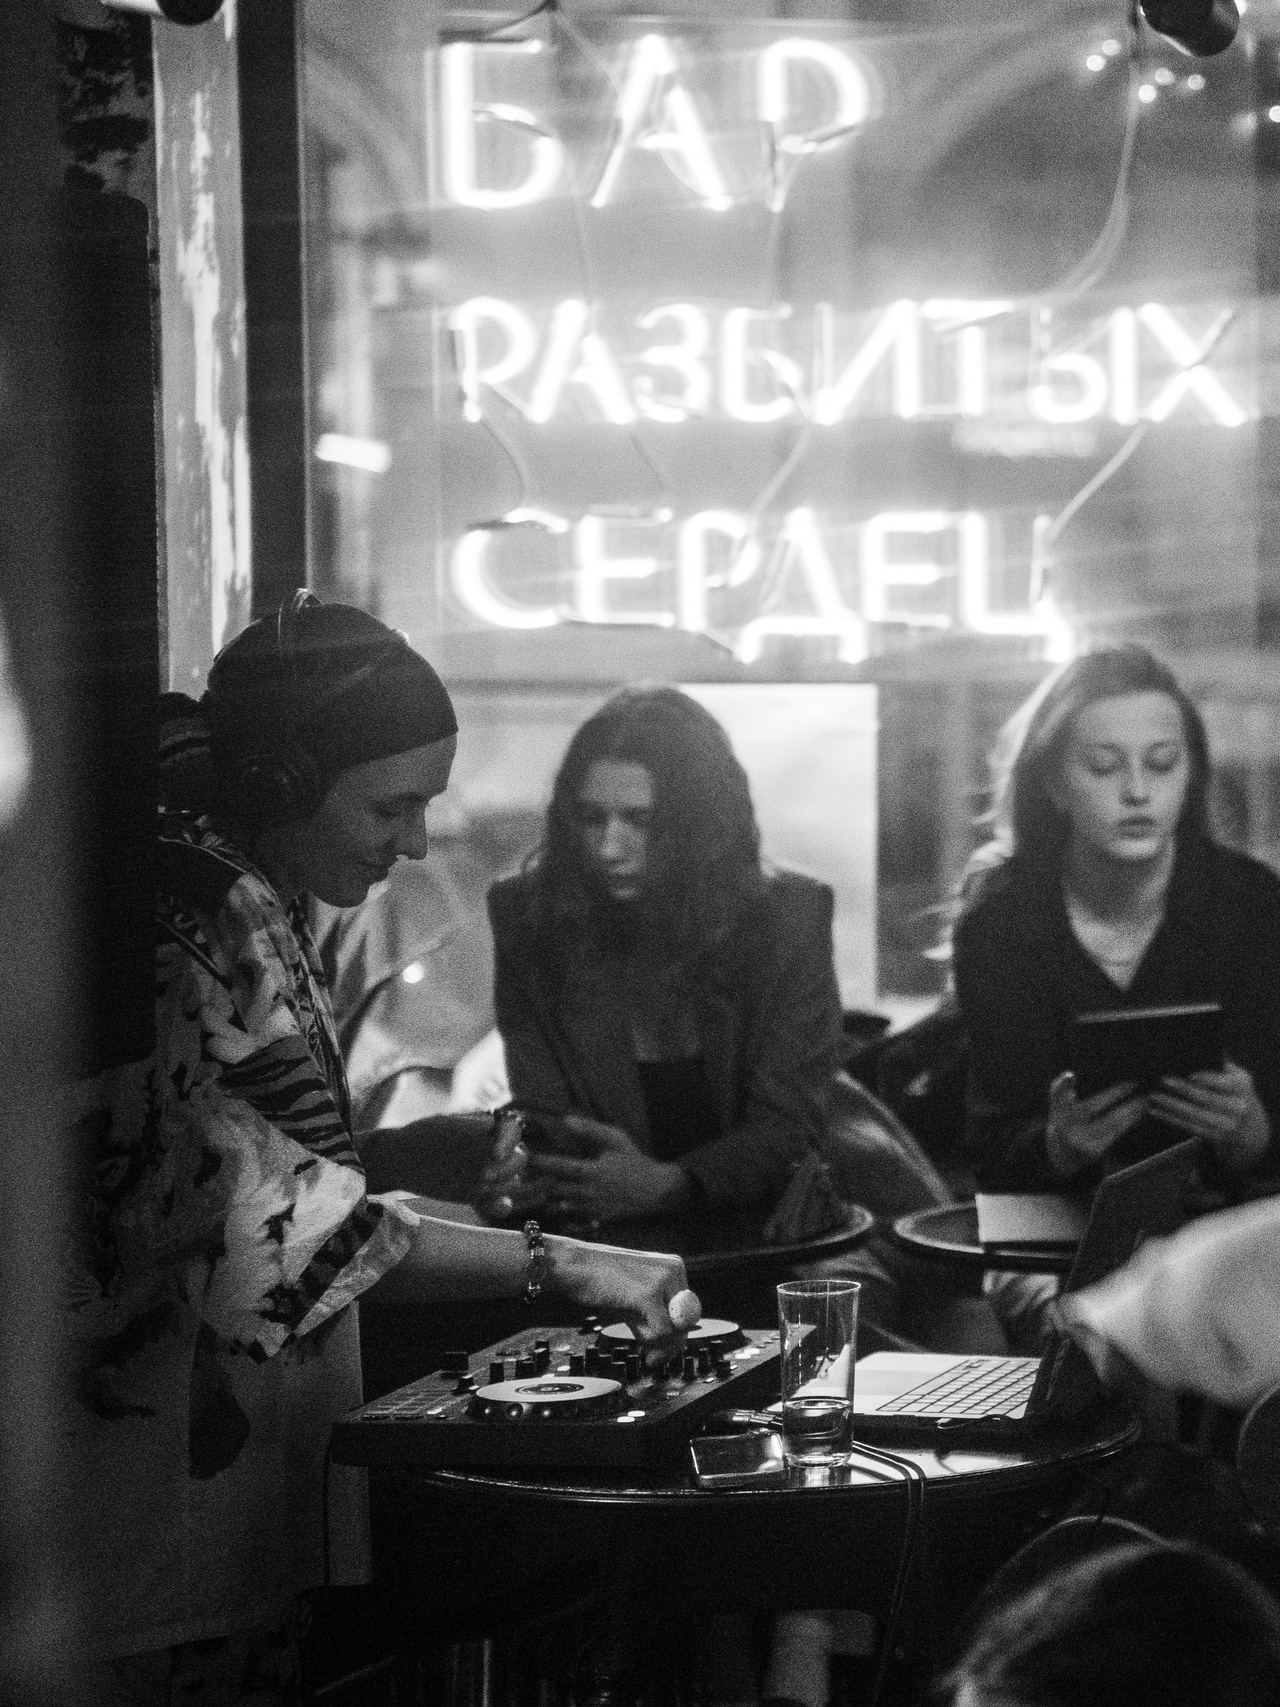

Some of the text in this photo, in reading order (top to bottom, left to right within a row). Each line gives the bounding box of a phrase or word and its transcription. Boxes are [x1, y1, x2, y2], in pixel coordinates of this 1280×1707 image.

[441, 34, 869, 212] БАР
[449, 296, 1248, 426] РАЗБИТЫХ
[450, 507, 1076, 663] СЕРДЕЦ
